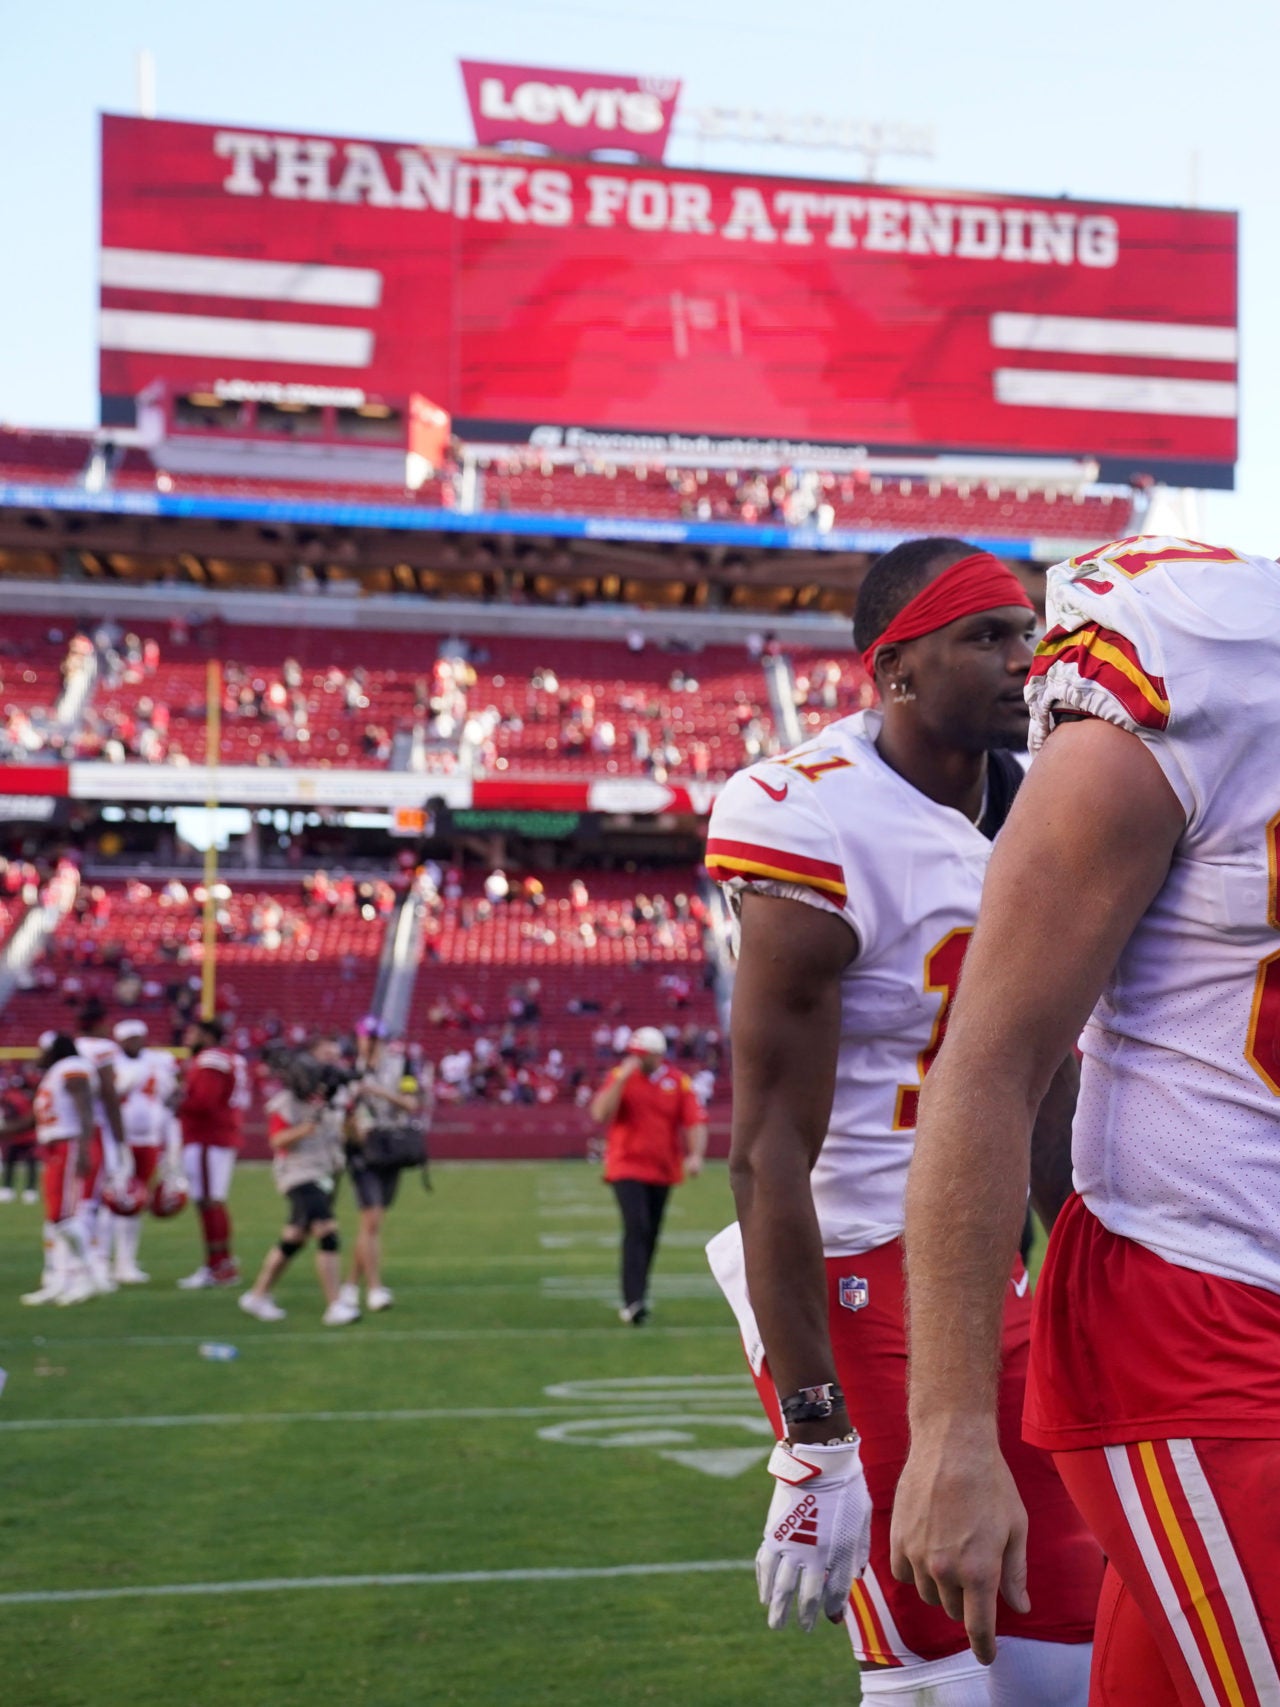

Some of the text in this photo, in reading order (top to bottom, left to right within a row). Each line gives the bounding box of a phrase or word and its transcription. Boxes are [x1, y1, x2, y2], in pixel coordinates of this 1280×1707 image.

[214, 131, 1118, 268] THANKS FOR ATTENDING
[844, 1291, 865, 1305] NFL
[773, 1493, 817, 1542] adidas
